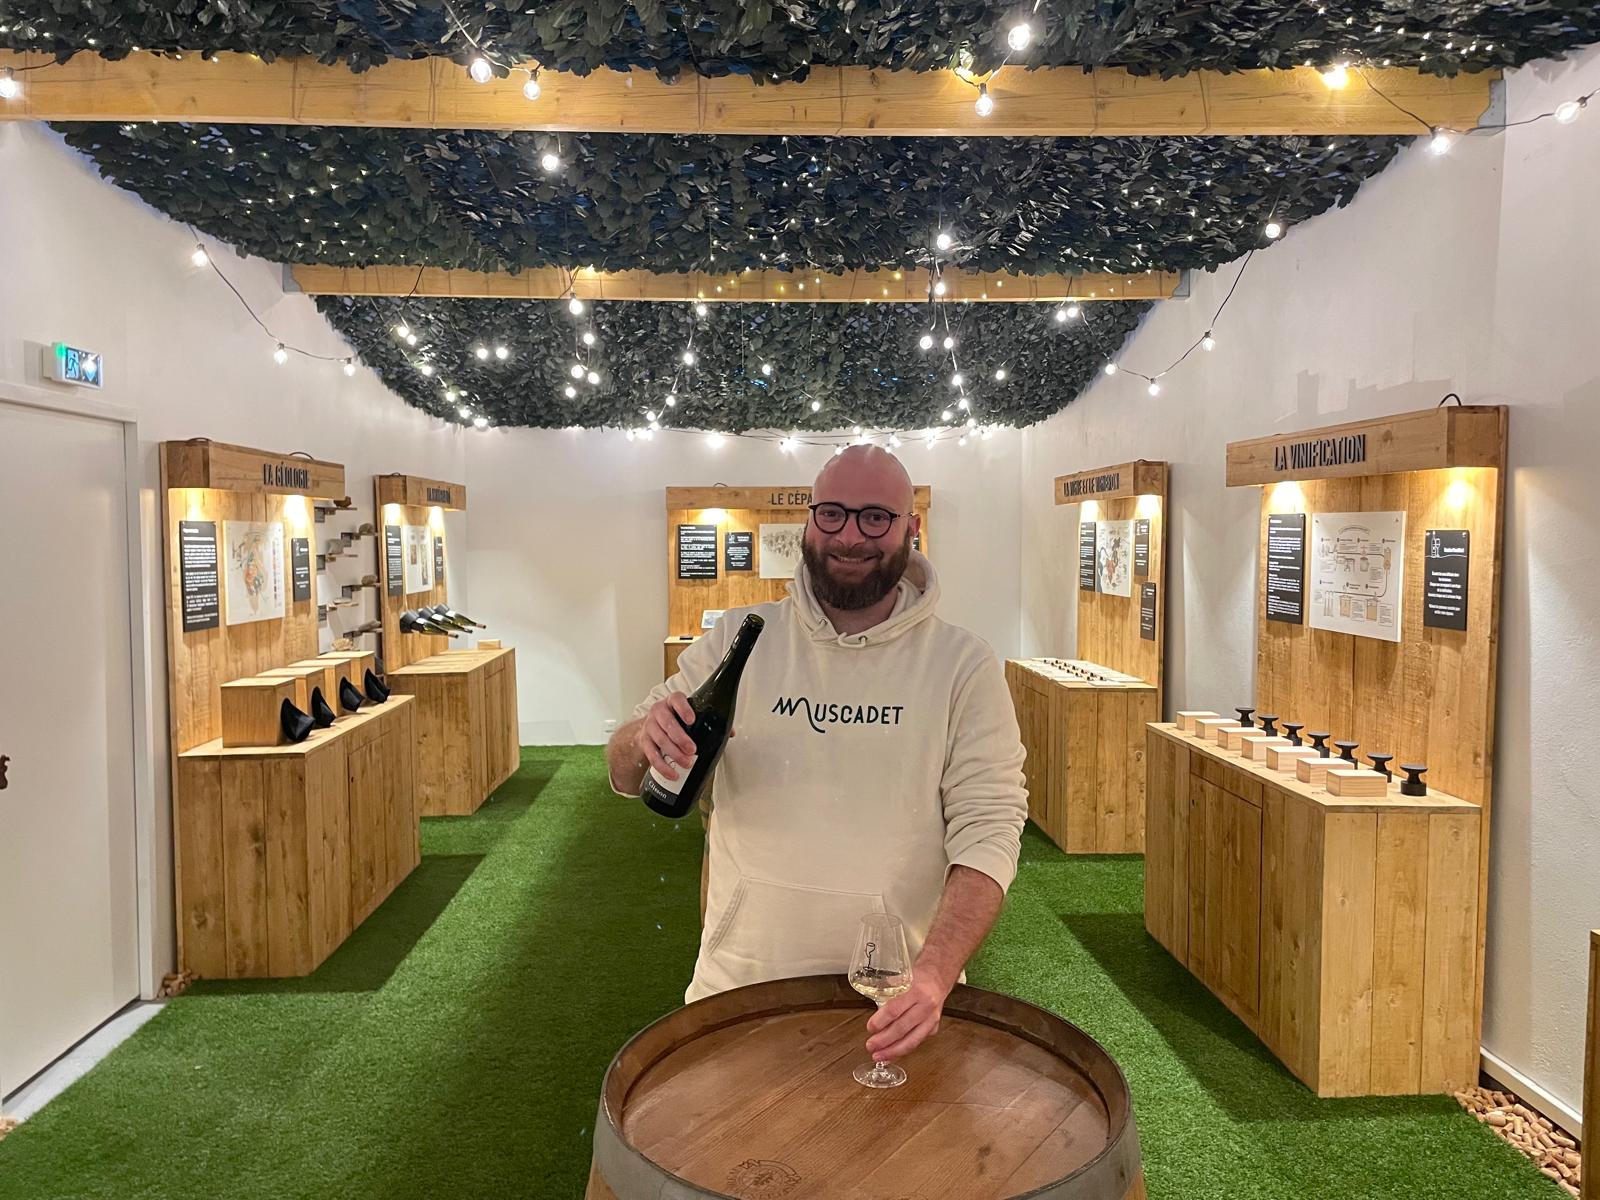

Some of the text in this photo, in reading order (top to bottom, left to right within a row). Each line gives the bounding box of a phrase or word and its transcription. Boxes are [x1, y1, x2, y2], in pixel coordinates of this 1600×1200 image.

[1275, 434, 1366, 470] LA VINIFICATION
[771, 490, 813, 505] LE CÉPA
[772, 697, 904, 733] MUSCADET
